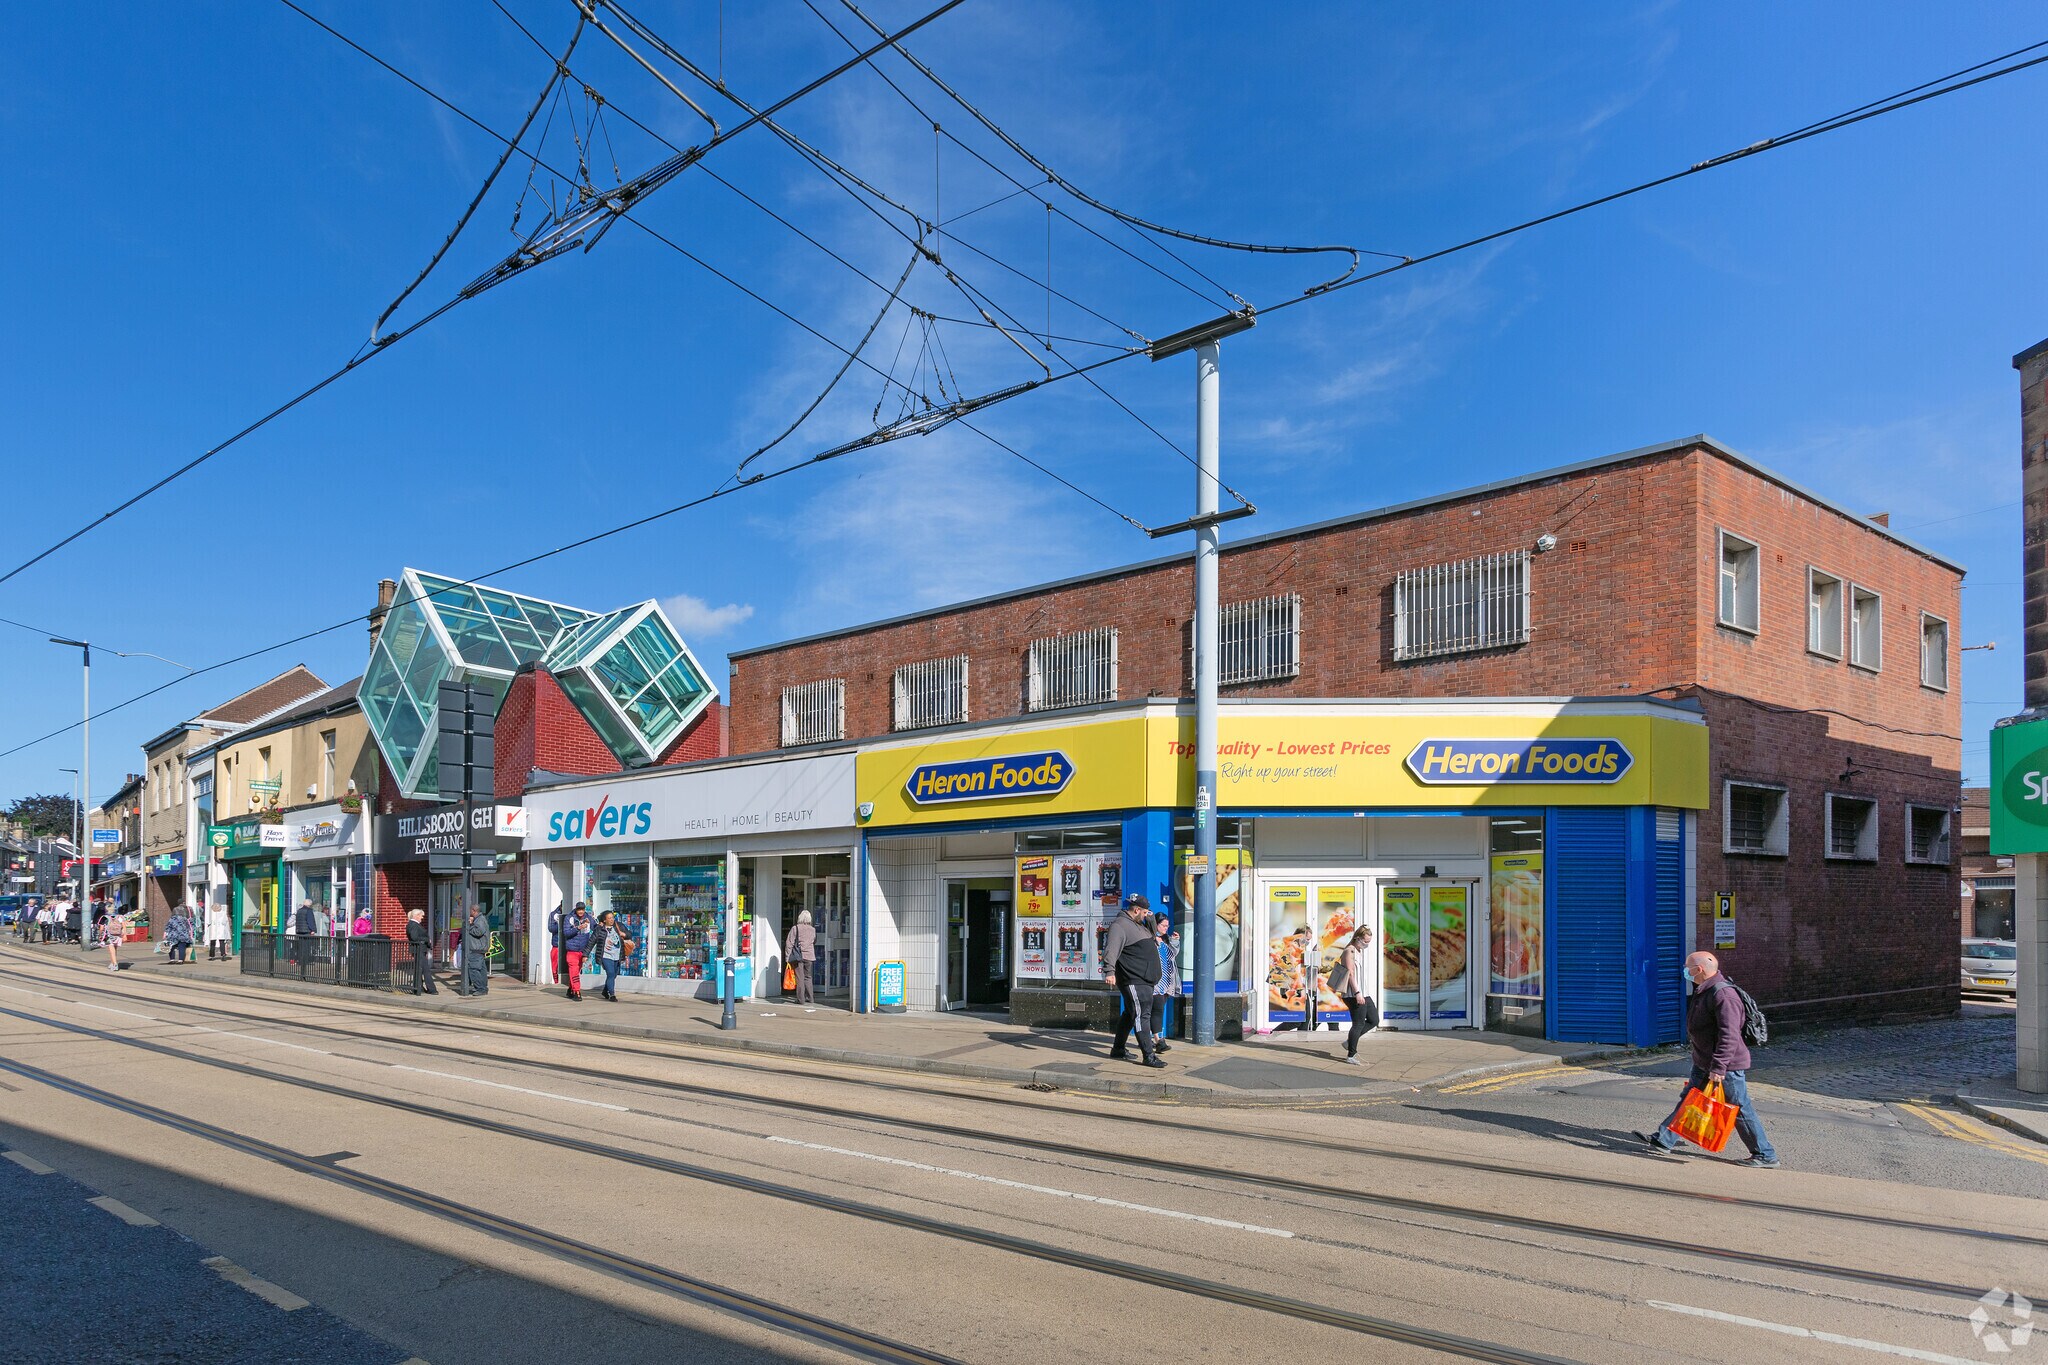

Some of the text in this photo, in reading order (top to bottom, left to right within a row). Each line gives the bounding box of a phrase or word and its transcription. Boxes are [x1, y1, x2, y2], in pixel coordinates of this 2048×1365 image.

[1168, 741, 1196, 759] Top
[1216, 741, 1262, 759] uality
[1277, 741, 1335, 755] Lowest
[1340, 741, 1391, 755] Prices
[1422, 744, 1619, 774] Heron Foods
[916, 756, 1062, 796] Heron Foods
[1221, 761, 1338, 784] Right up your street!
[397, 806, 494, 838] HILLSBOROGH
[547, 793, 653, 842] savers
[684, 818, 718, 830] HEALTH
[731, 814, 759, 826] HOME
[774, 810, 813, 823] BEAUTY
[414, 833, 465, 855] EXCHANG
[1065, 873, 1078, 888] £2
[1103, 872, 1116, 887] £2
[1722, 899, 1729, 915] P
[1027, 932, 1040, 946] £1
[1065, 932, 1078, 946] £1
[881, 967, 902, 976] FREE
[881, 975, 902, 983] CASH
[881, 987, 902, 995] HERE
